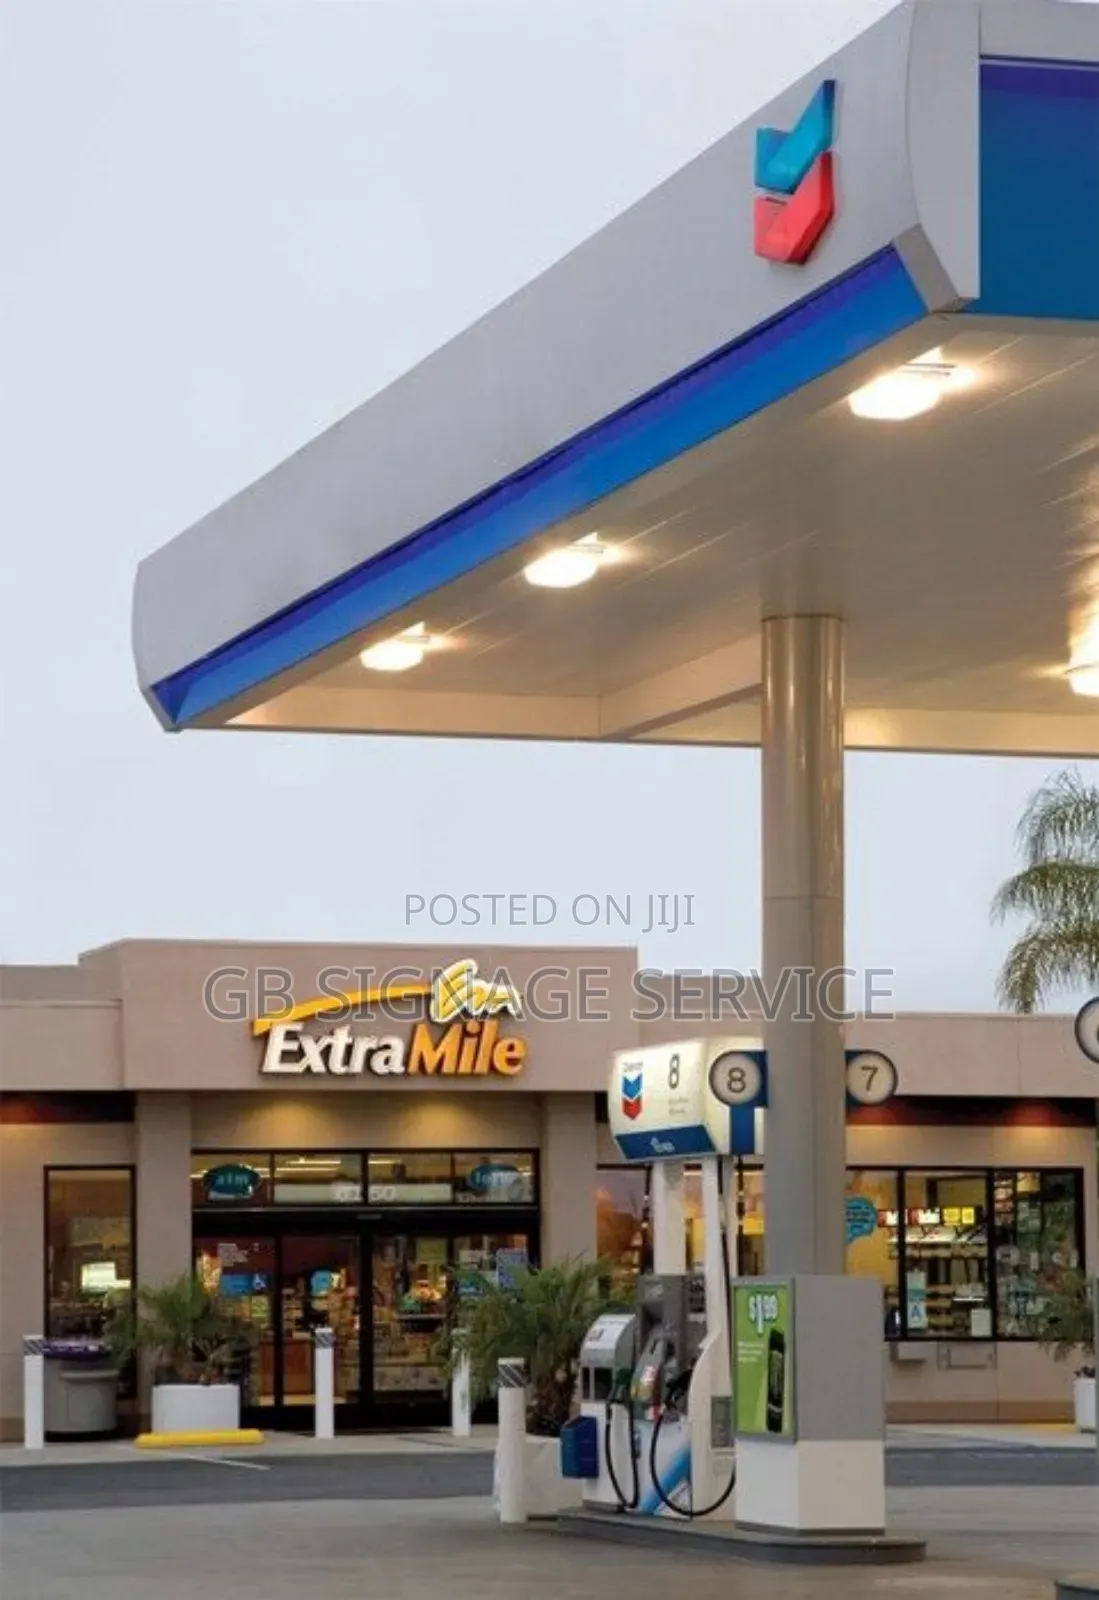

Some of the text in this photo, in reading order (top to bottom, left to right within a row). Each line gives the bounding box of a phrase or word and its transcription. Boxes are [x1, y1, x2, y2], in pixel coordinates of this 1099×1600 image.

[261, 1019, 528, 1076] ExtraMile
[668, 1053, 680, 1089] 8
[726, 1066, 747, 1094] 8
[860, 1065, 879, 1091] 7
